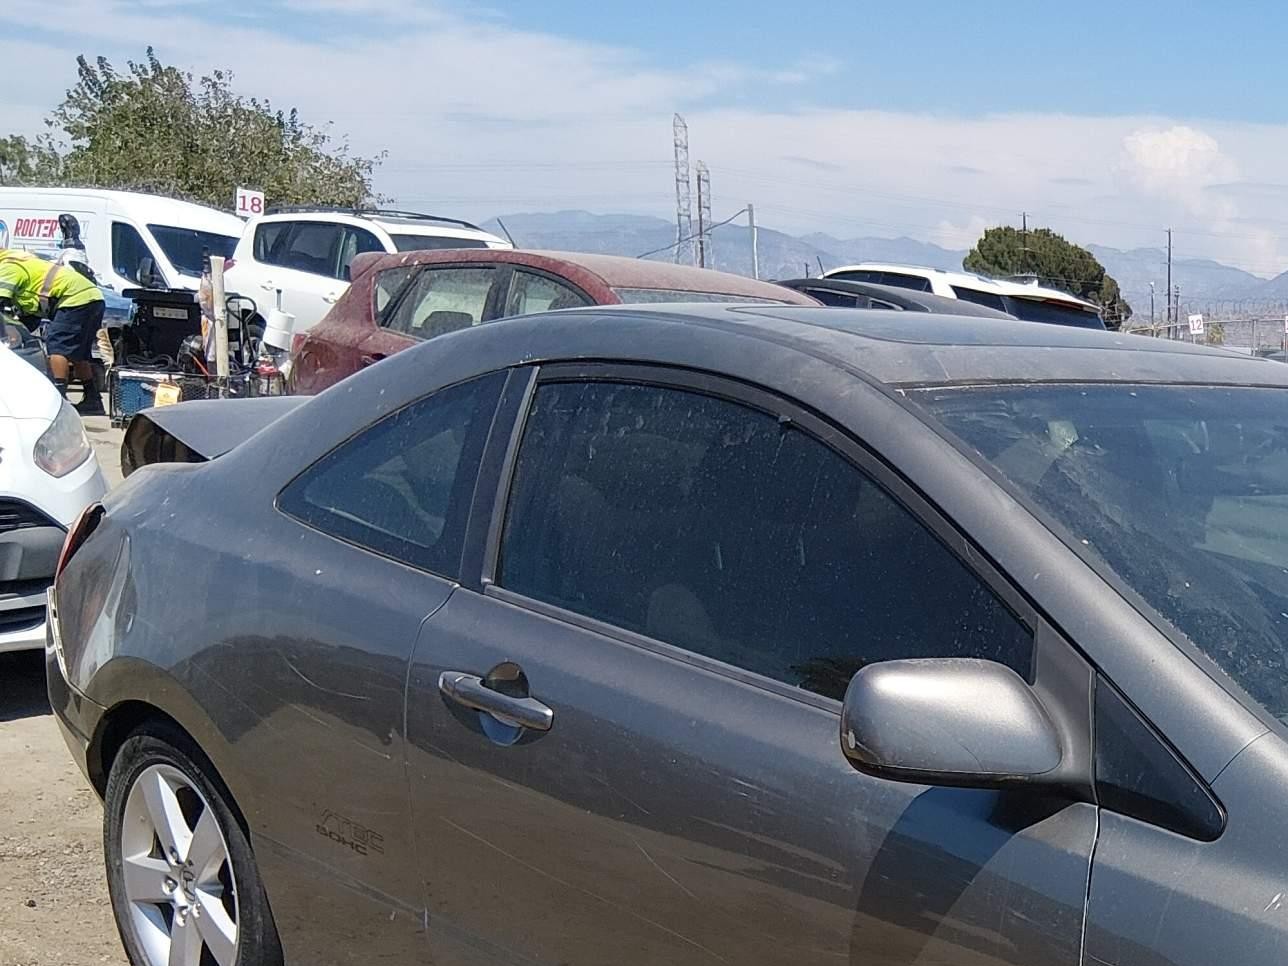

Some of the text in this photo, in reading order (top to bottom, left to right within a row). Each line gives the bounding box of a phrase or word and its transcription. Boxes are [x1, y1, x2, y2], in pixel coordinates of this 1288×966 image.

[238, 195, 262, 214] 18
[13, 218, 58, 239] ROOTER
[1190, 319, 1203, 331] 12
